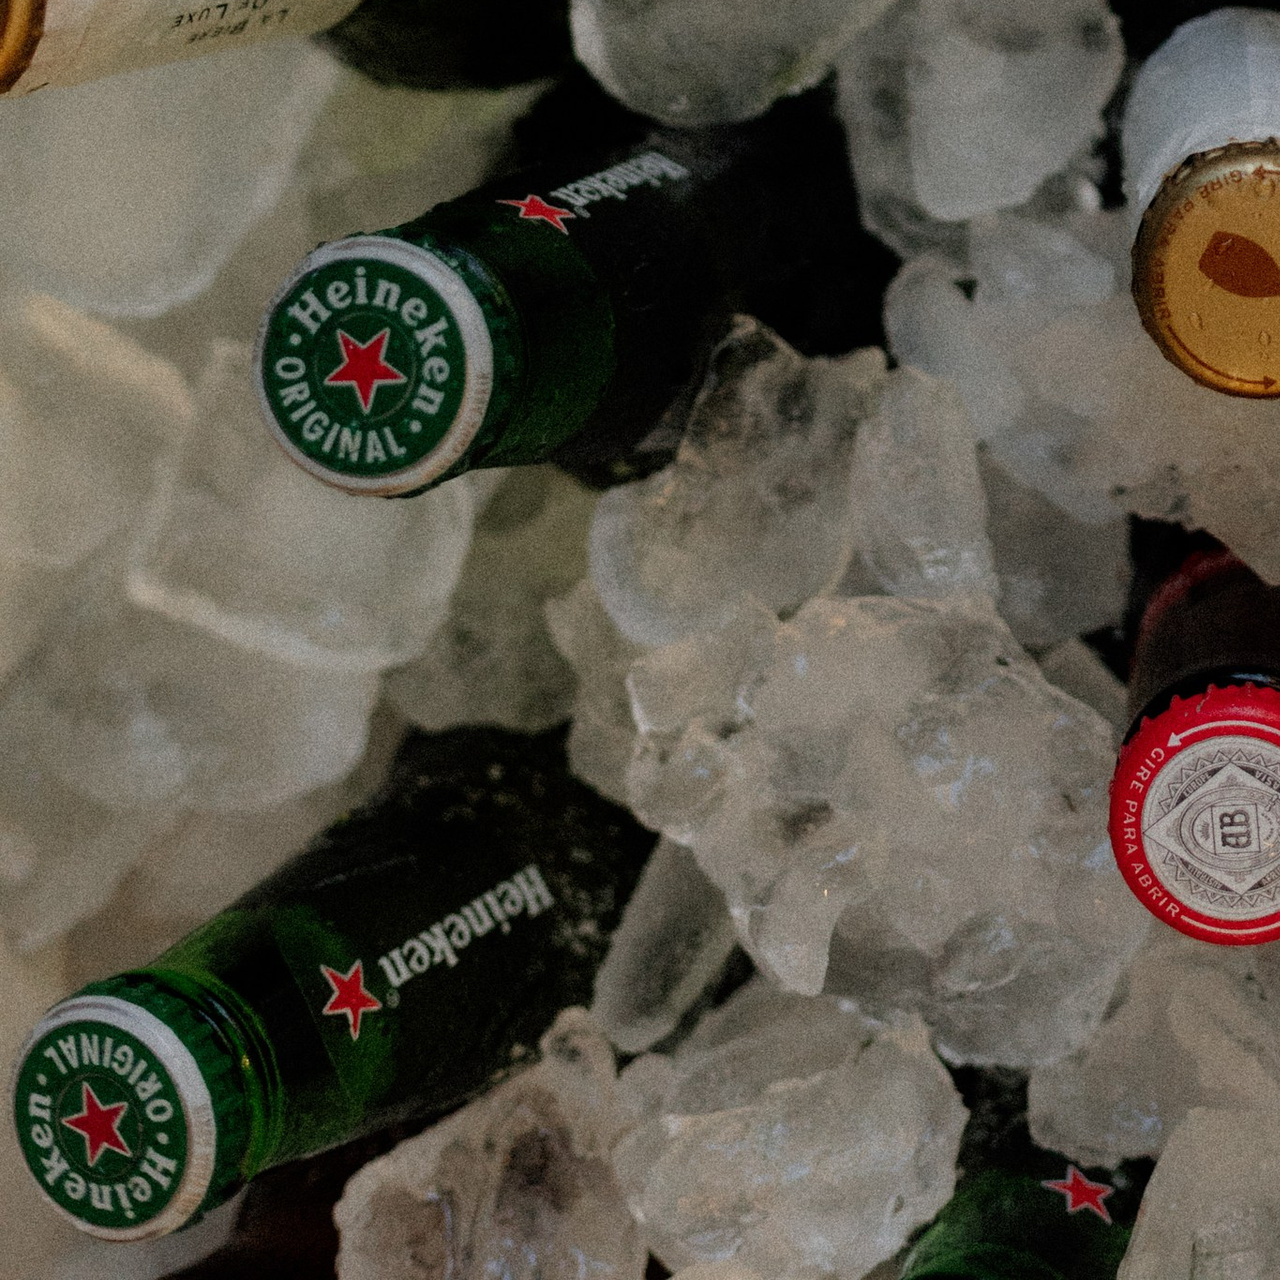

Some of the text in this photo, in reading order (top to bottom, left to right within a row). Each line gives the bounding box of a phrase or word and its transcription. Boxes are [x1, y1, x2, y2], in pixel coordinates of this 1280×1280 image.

[1196, 169, 1243, 200] GIRE
[289, 266, 450, 418] Heineken
[273, 355, 408, 465] ORIGINAL
[1122, 745, 1180, 919] GIRE PARA ABRIR
[376, 863, 556, 989] Heineken
[44, 1032, 175, 1123] ORIGINAL
[29, 1091, 178, 1221] Heineken
